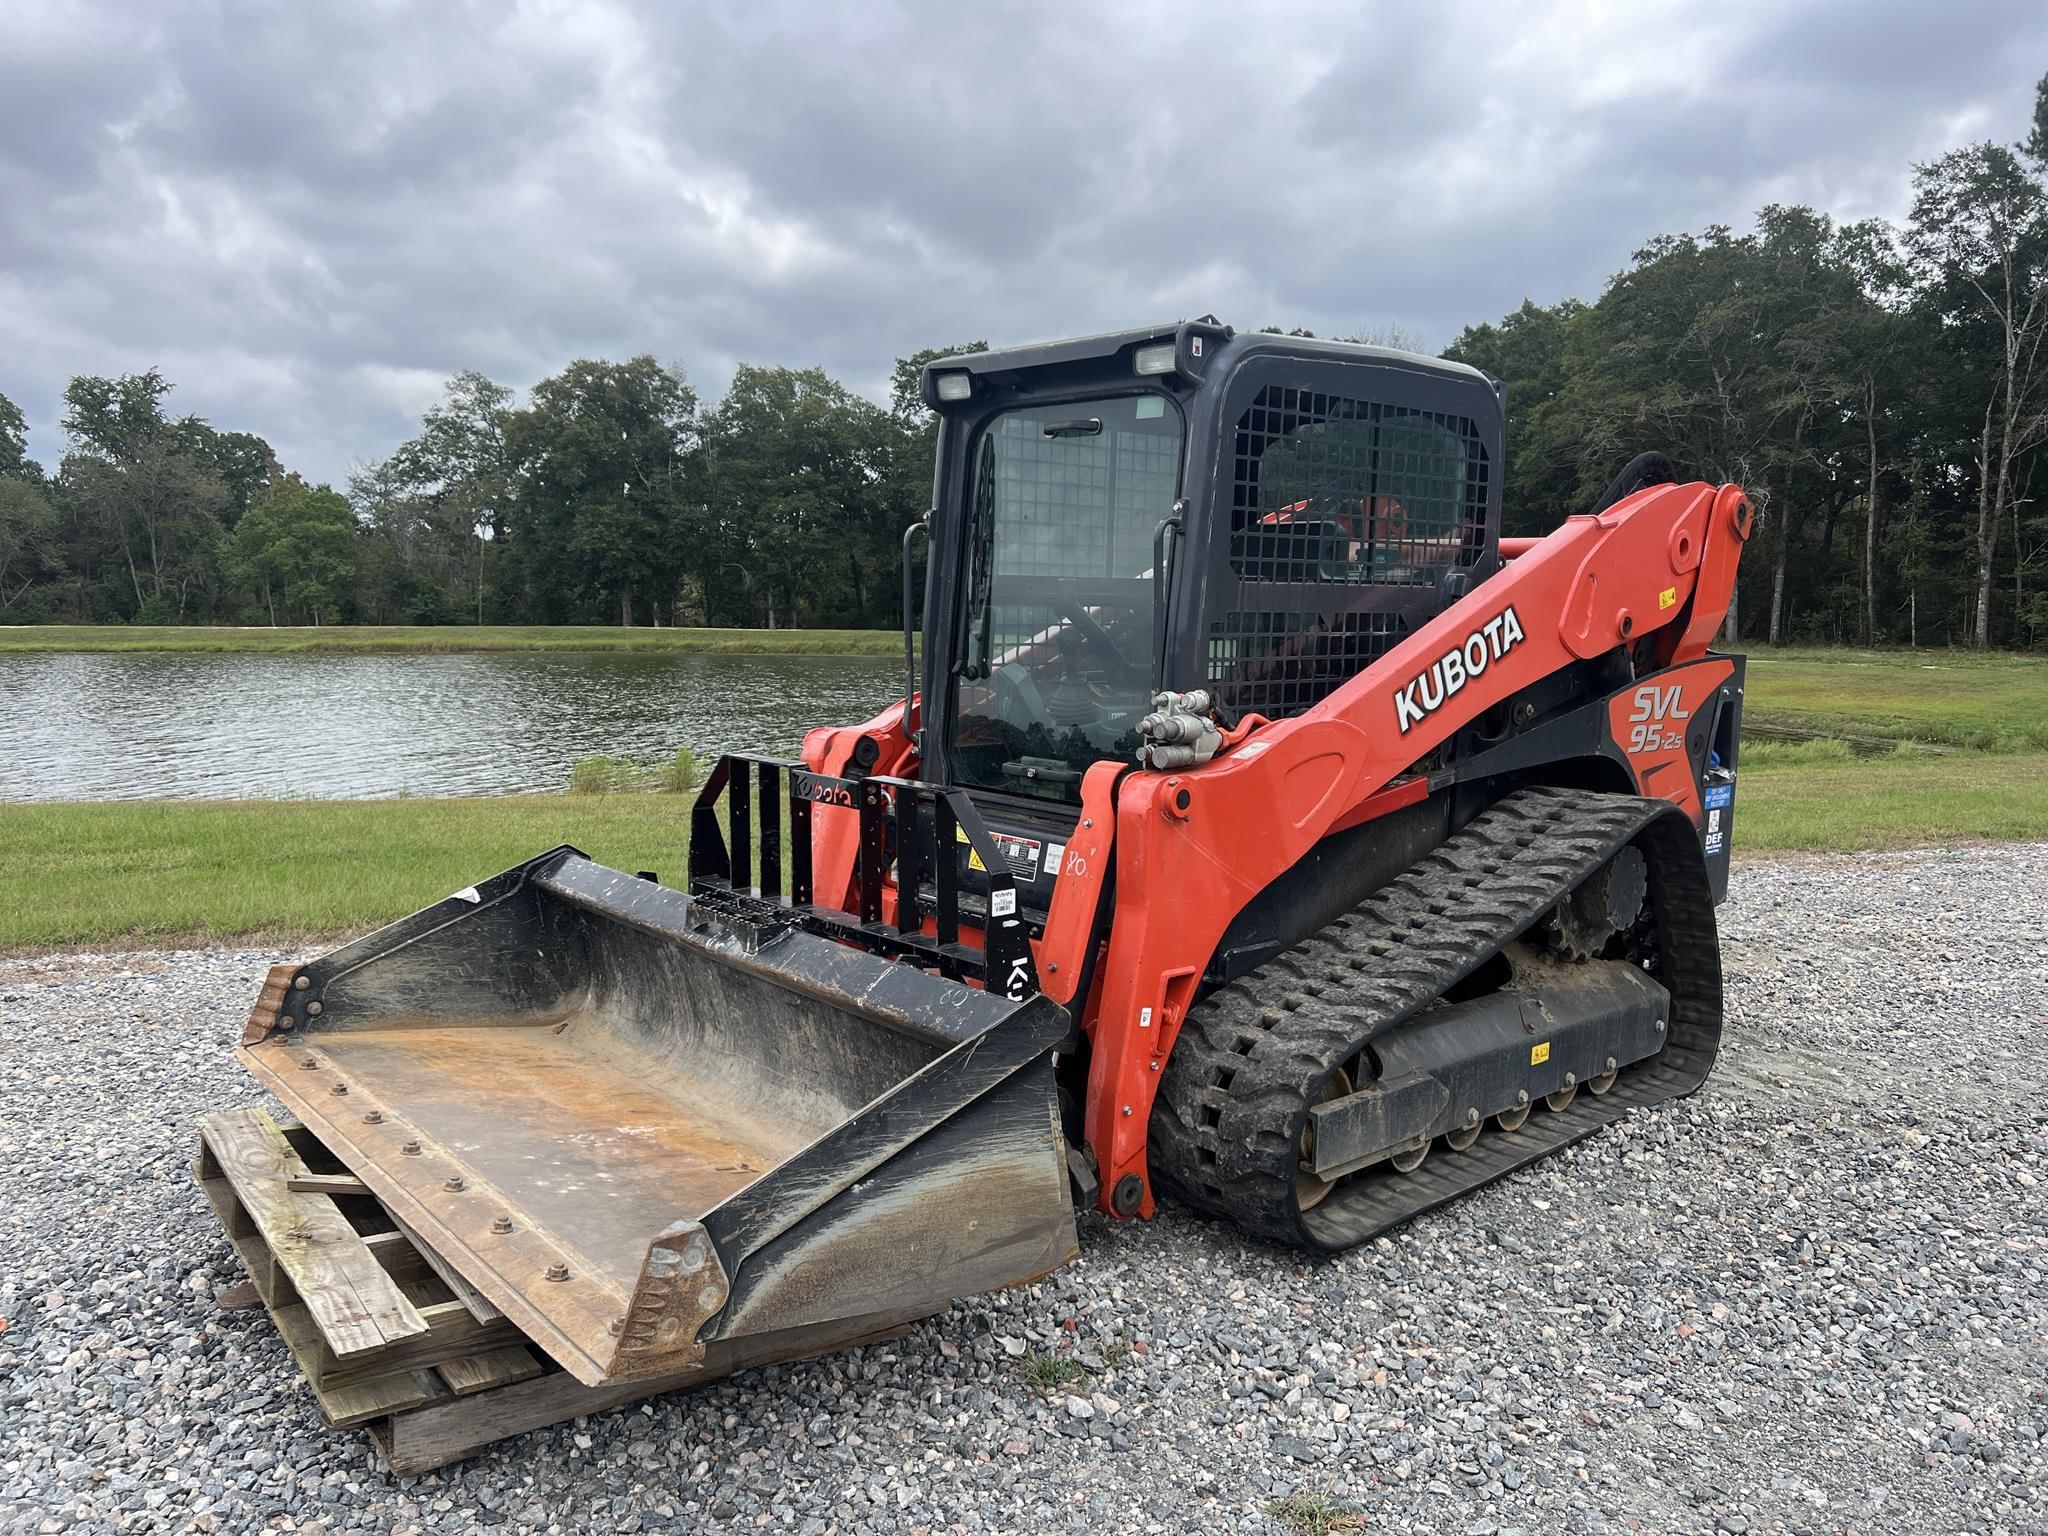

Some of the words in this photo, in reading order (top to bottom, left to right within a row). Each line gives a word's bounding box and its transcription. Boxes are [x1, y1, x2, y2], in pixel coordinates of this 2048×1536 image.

[1394, 607, 1524, 733] KUBOTA
[1629, 686, 1690, 722] SVL
[1705, 832, 1723, 845] DEF
